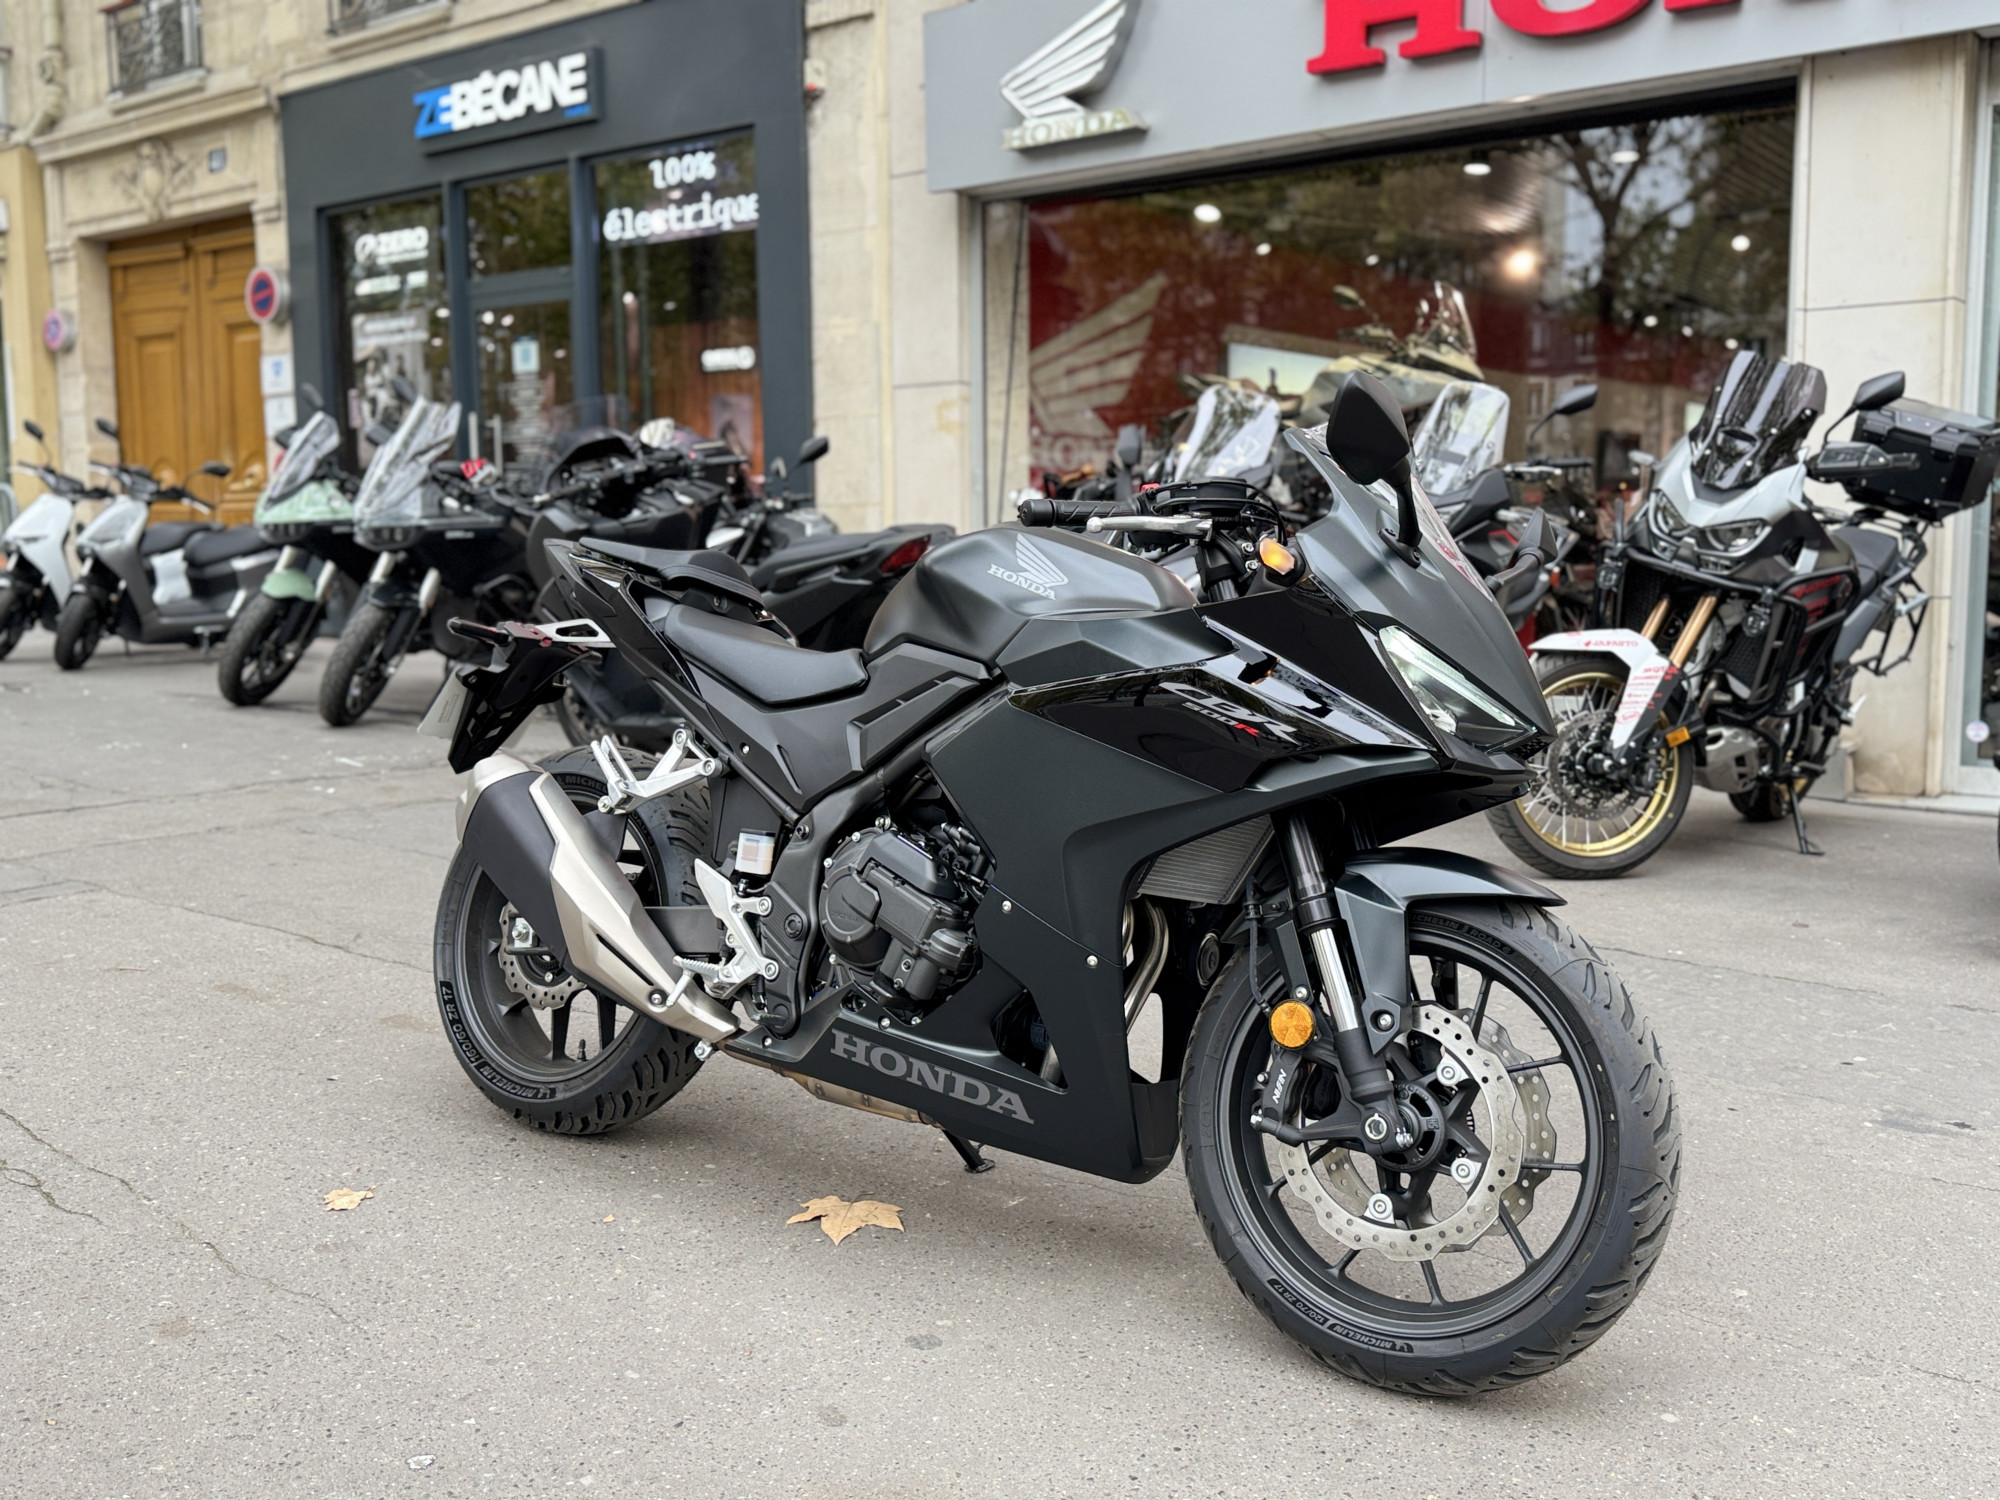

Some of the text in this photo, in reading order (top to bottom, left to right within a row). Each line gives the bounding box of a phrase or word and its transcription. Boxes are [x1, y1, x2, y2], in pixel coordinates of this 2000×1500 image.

[1002, 108, 1133, 149] HONDA
[648, 150, 717, 189] 100%
[987, 563, 1056, 600] HONDA
[1159, 682, 1302, 748] CBR
[566, 775, 608, 794] MICHEL
[1469, 928, 1501, 948] ROAD
[441, 986, 480, 1065] 160/60 ZR 17
[480, 1065, 537, 1098] MICHELIN
[830, 1027, 1035, 1125] HONDA
[1273, 1283, 1326, 1326] 120/70 ZR 17
[1333, 1325, 1393, 1350] MICHELIN
